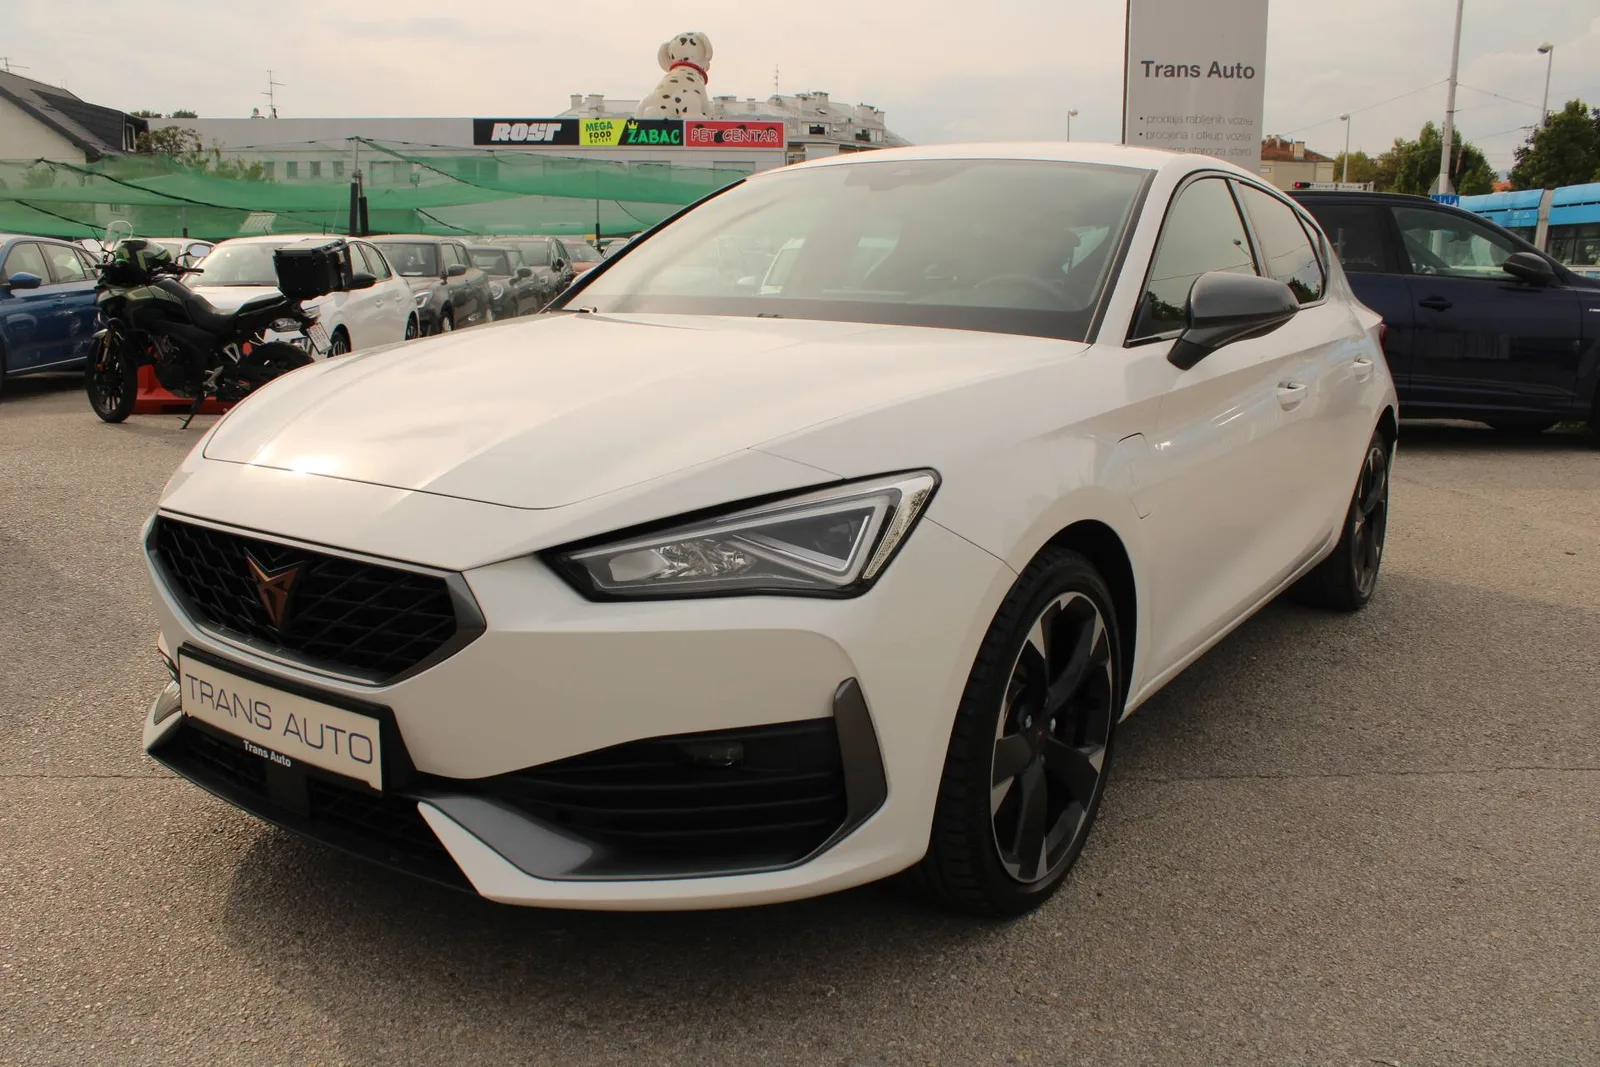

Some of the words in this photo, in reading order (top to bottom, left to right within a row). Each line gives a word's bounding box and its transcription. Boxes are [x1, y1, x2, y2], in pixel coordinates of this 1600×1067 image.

[1141, 60, 1200, 78] Trans
[1207, 61, 1255, 79] Auto
[585, 121, 613, 132] MEGA
[1146, 113, 1184, 126] prodaja
[491, 122, 562, 141] ROST
[589, 131, 611, 139] FOOD
[692, 128, 717, 142] PET
[722, 129, 778, 142] CENTAR
[185, 673, 272, 731] TRANS
[283, 713, 373, 765] AUTO
[243, 740, 269, 759] Trans
[270, 751, 291, 768] Auto
